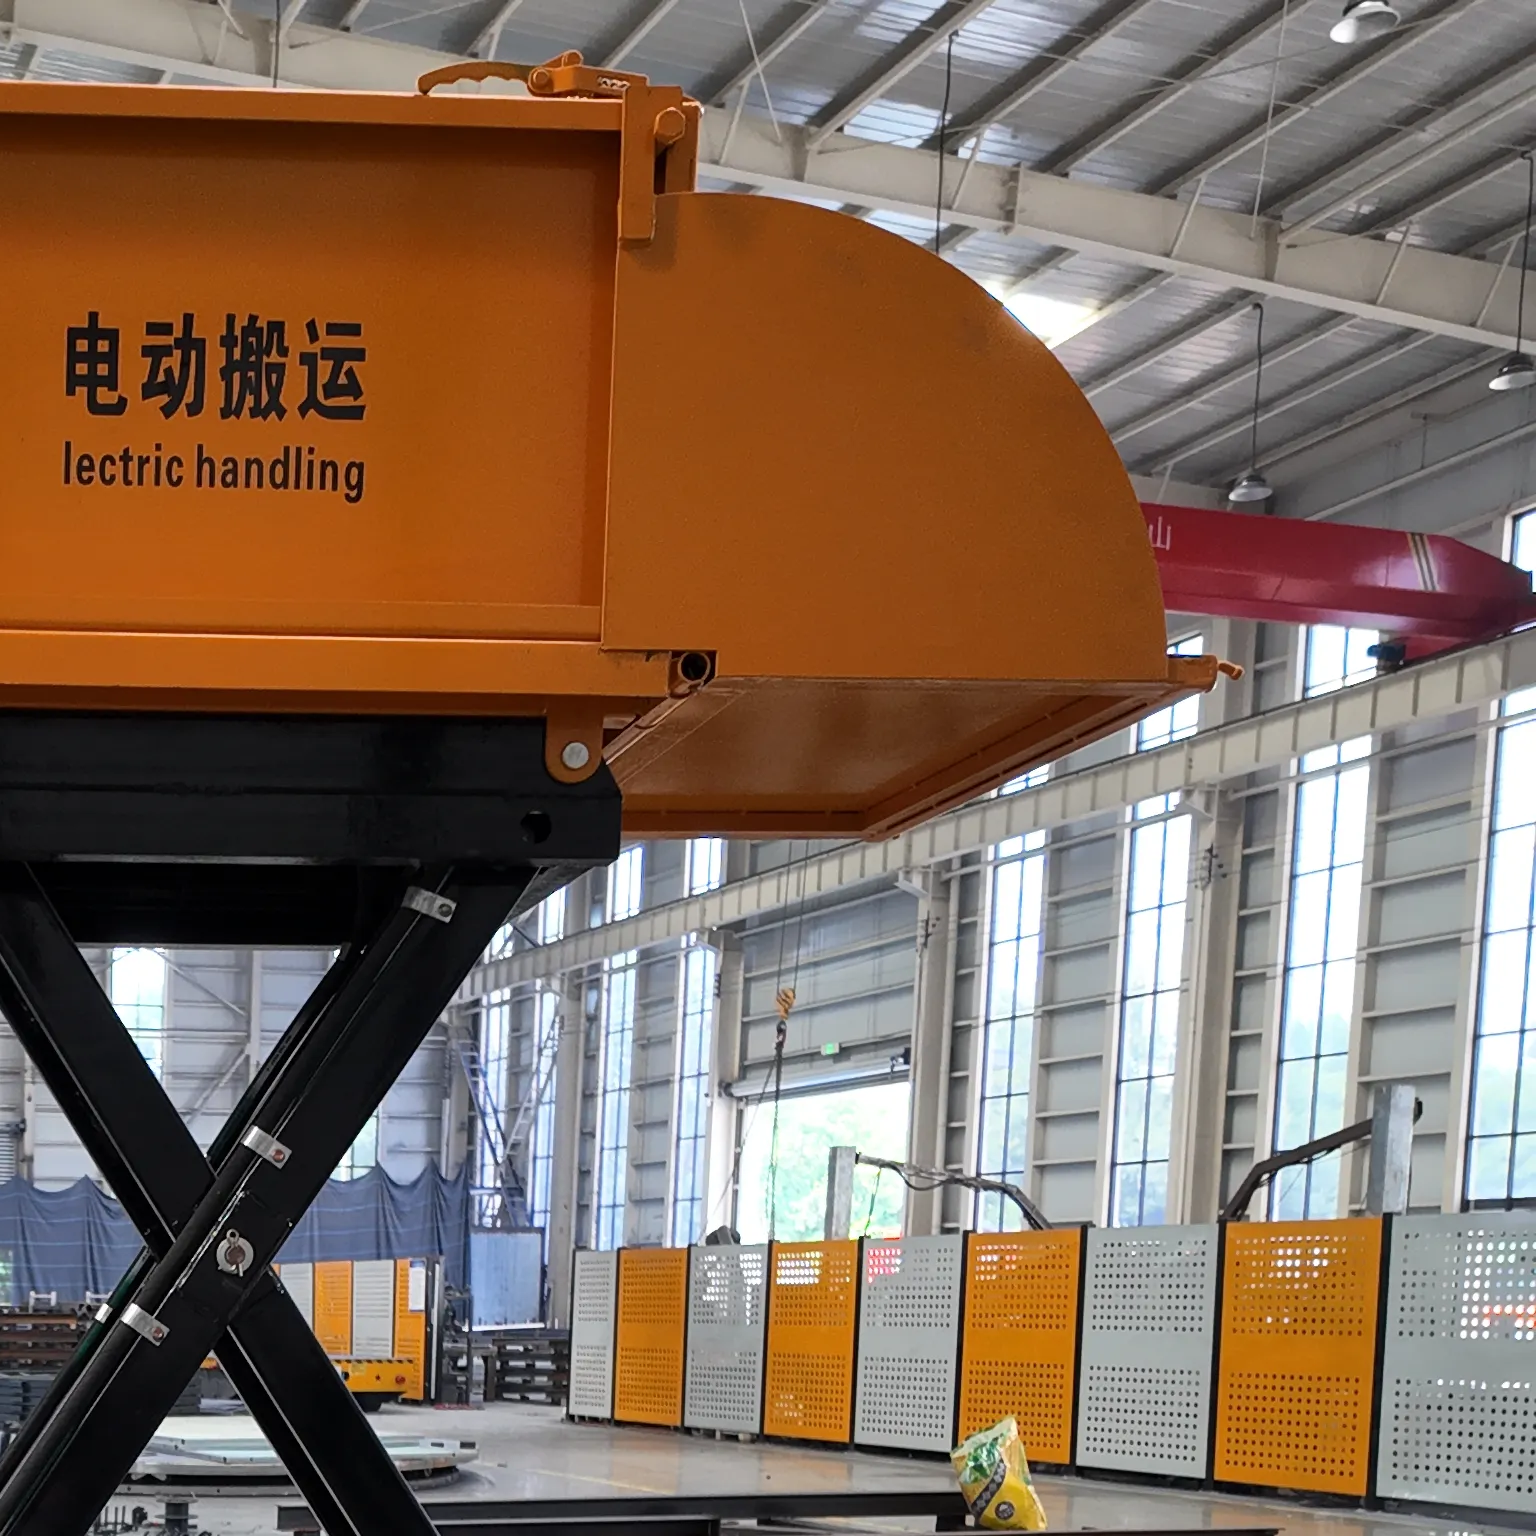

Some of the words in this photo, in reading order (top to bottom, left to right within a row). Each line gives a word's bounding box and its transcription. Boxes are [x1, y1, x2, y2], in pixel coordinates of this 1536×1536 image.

[65, 311, 367, 422] 电动搬运
[63, 440, 184, 488] lectric
[196, 443, 365, 504] handling
[1149, 515, 1172, 551] 山
